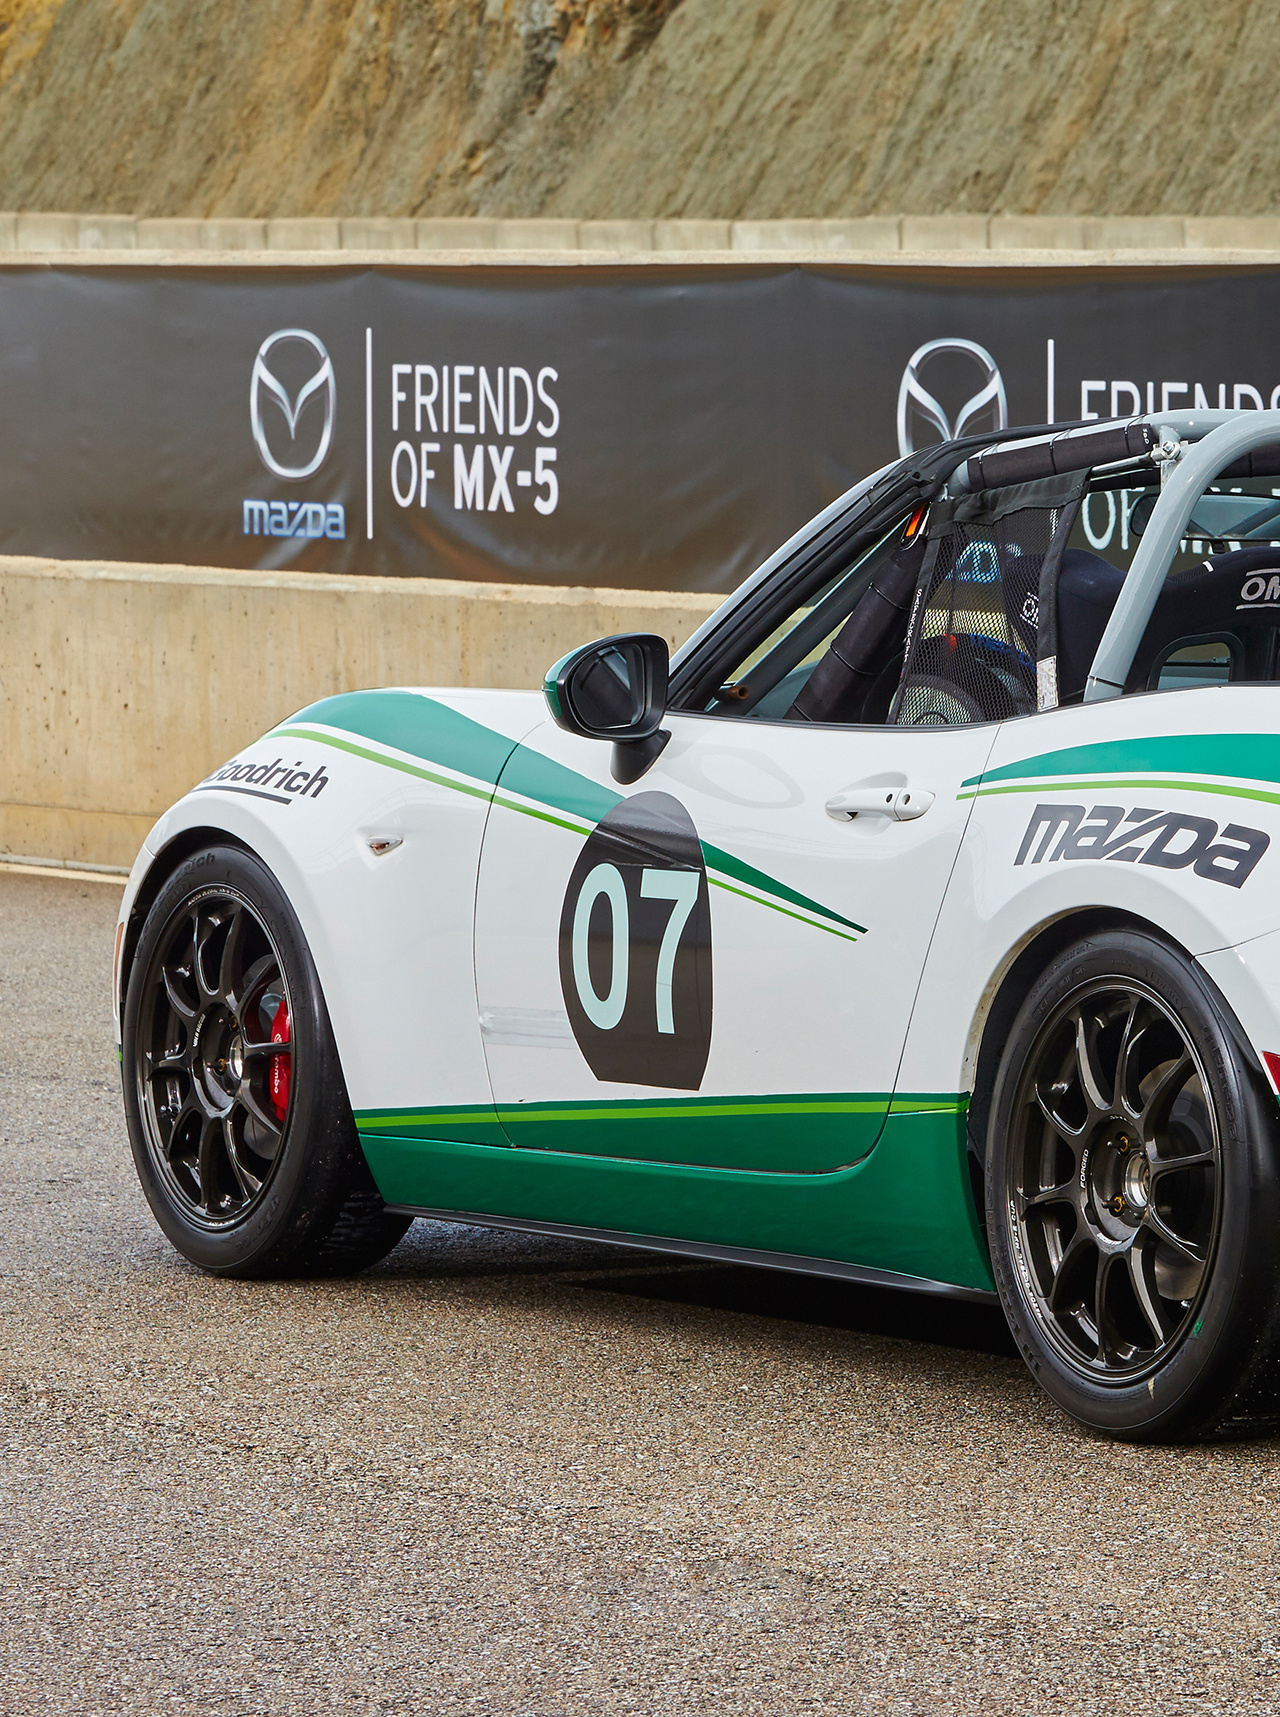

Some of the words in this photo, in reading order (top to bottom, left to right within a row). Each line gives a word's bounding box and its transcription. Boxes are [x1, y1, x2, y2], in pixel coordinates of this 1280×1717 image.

[391, 363, 560, 438] FRIENDS
[391, 440, 441, 508] OF
[453, 443, 560, 515] MX-5
[572, 862, 701, 1034] 07
[1079, 1148, 1090, 1190] FORGED
